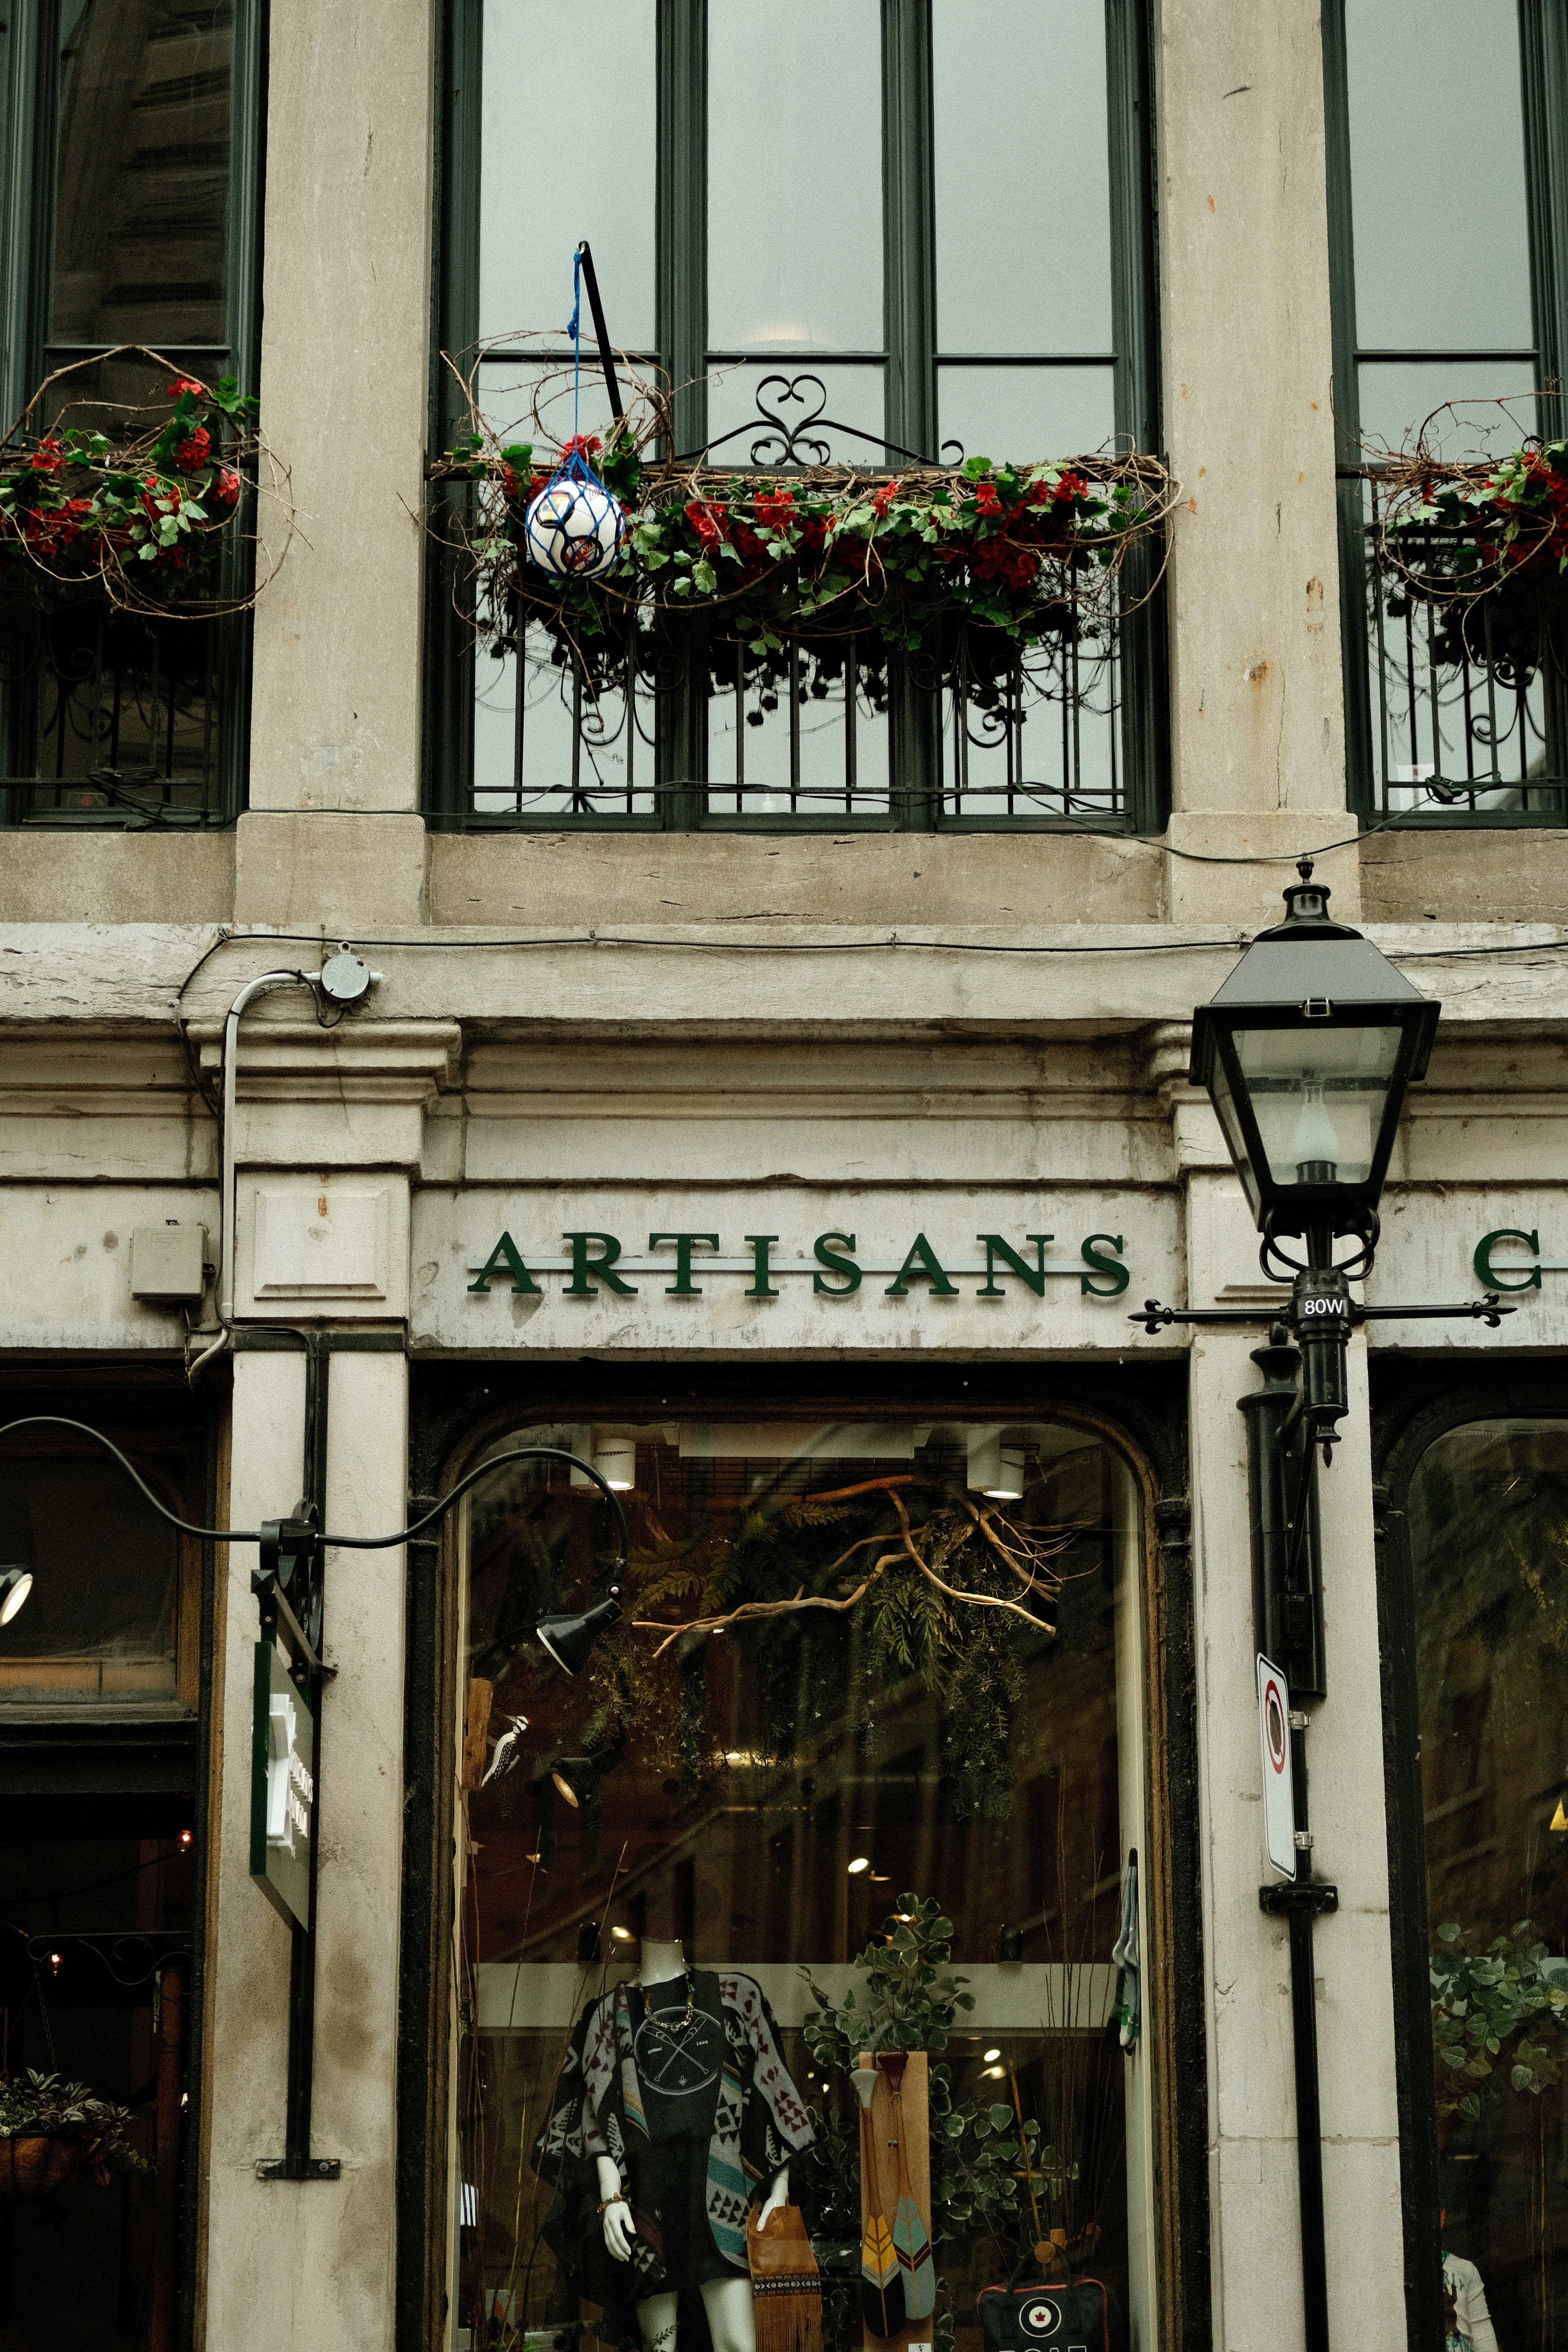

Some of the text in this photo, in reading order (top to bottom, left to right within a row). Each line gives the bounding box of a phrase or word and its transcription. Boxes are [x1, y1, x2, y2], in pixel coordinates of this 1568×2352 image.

[467, 1231, 1130, 1298] ARTISANS
[1474, 1229, 1542, 1292] C
[1305, 1299, 1343, 1314] 80W
